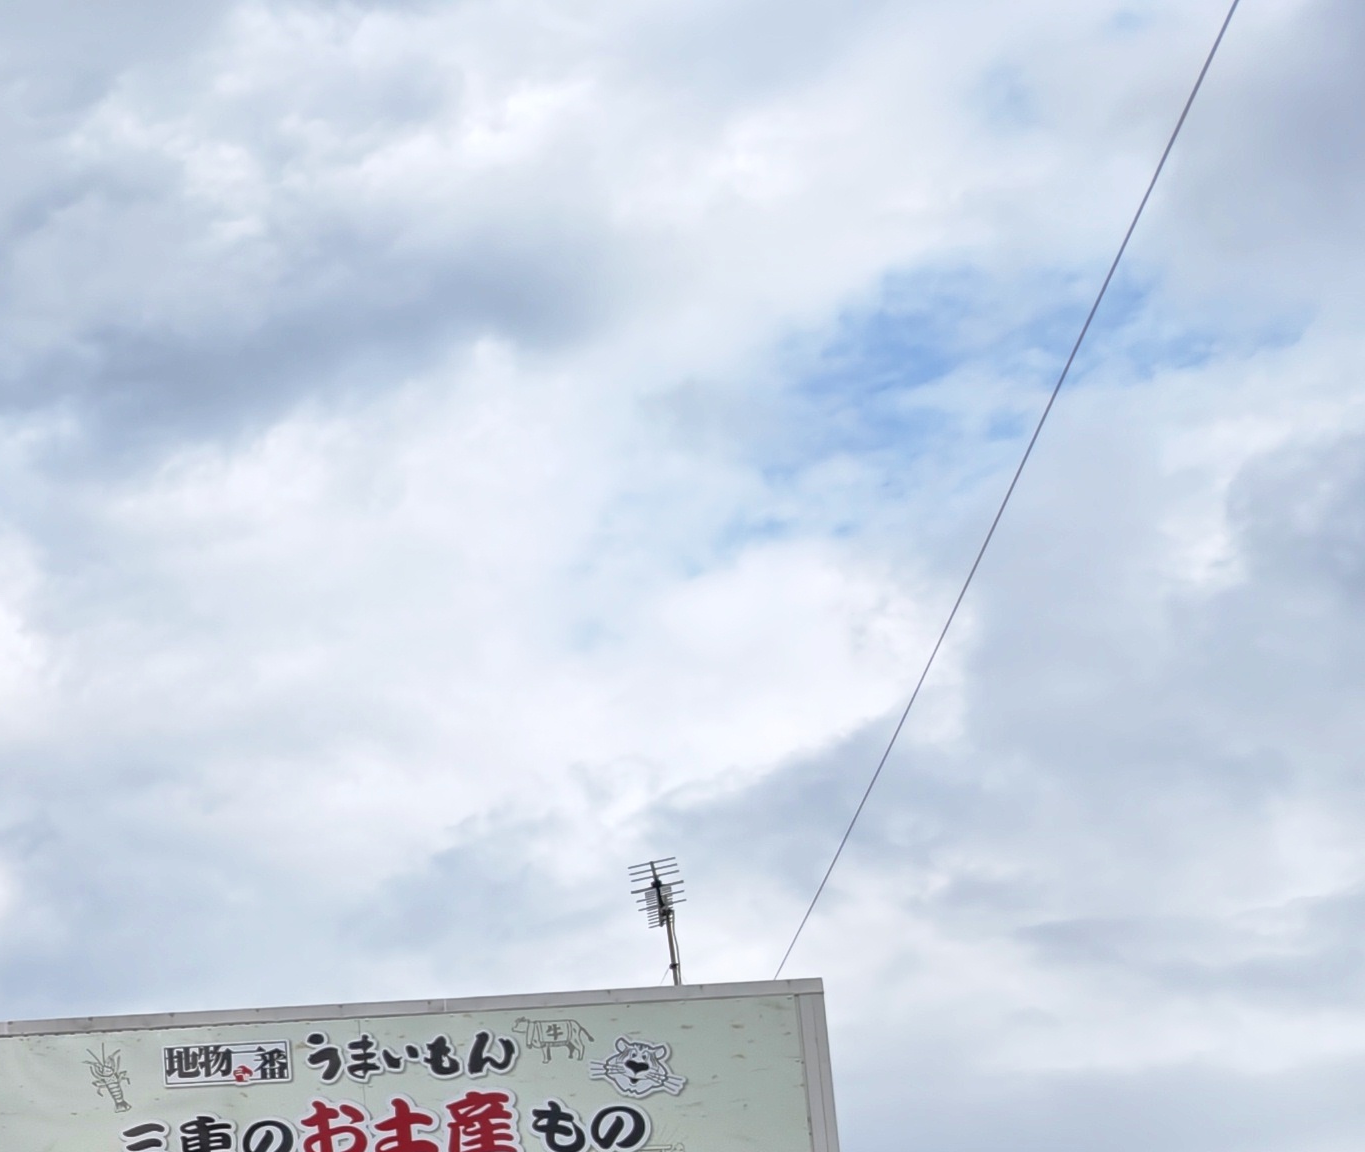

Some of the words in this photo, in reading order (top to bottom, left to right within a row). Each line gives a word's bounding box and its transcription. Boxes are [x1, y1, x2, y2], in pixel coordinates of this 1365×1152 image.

[546, 1024, 564, 1041] 牛
[306, 1030, 516, 1080] うまいもん
